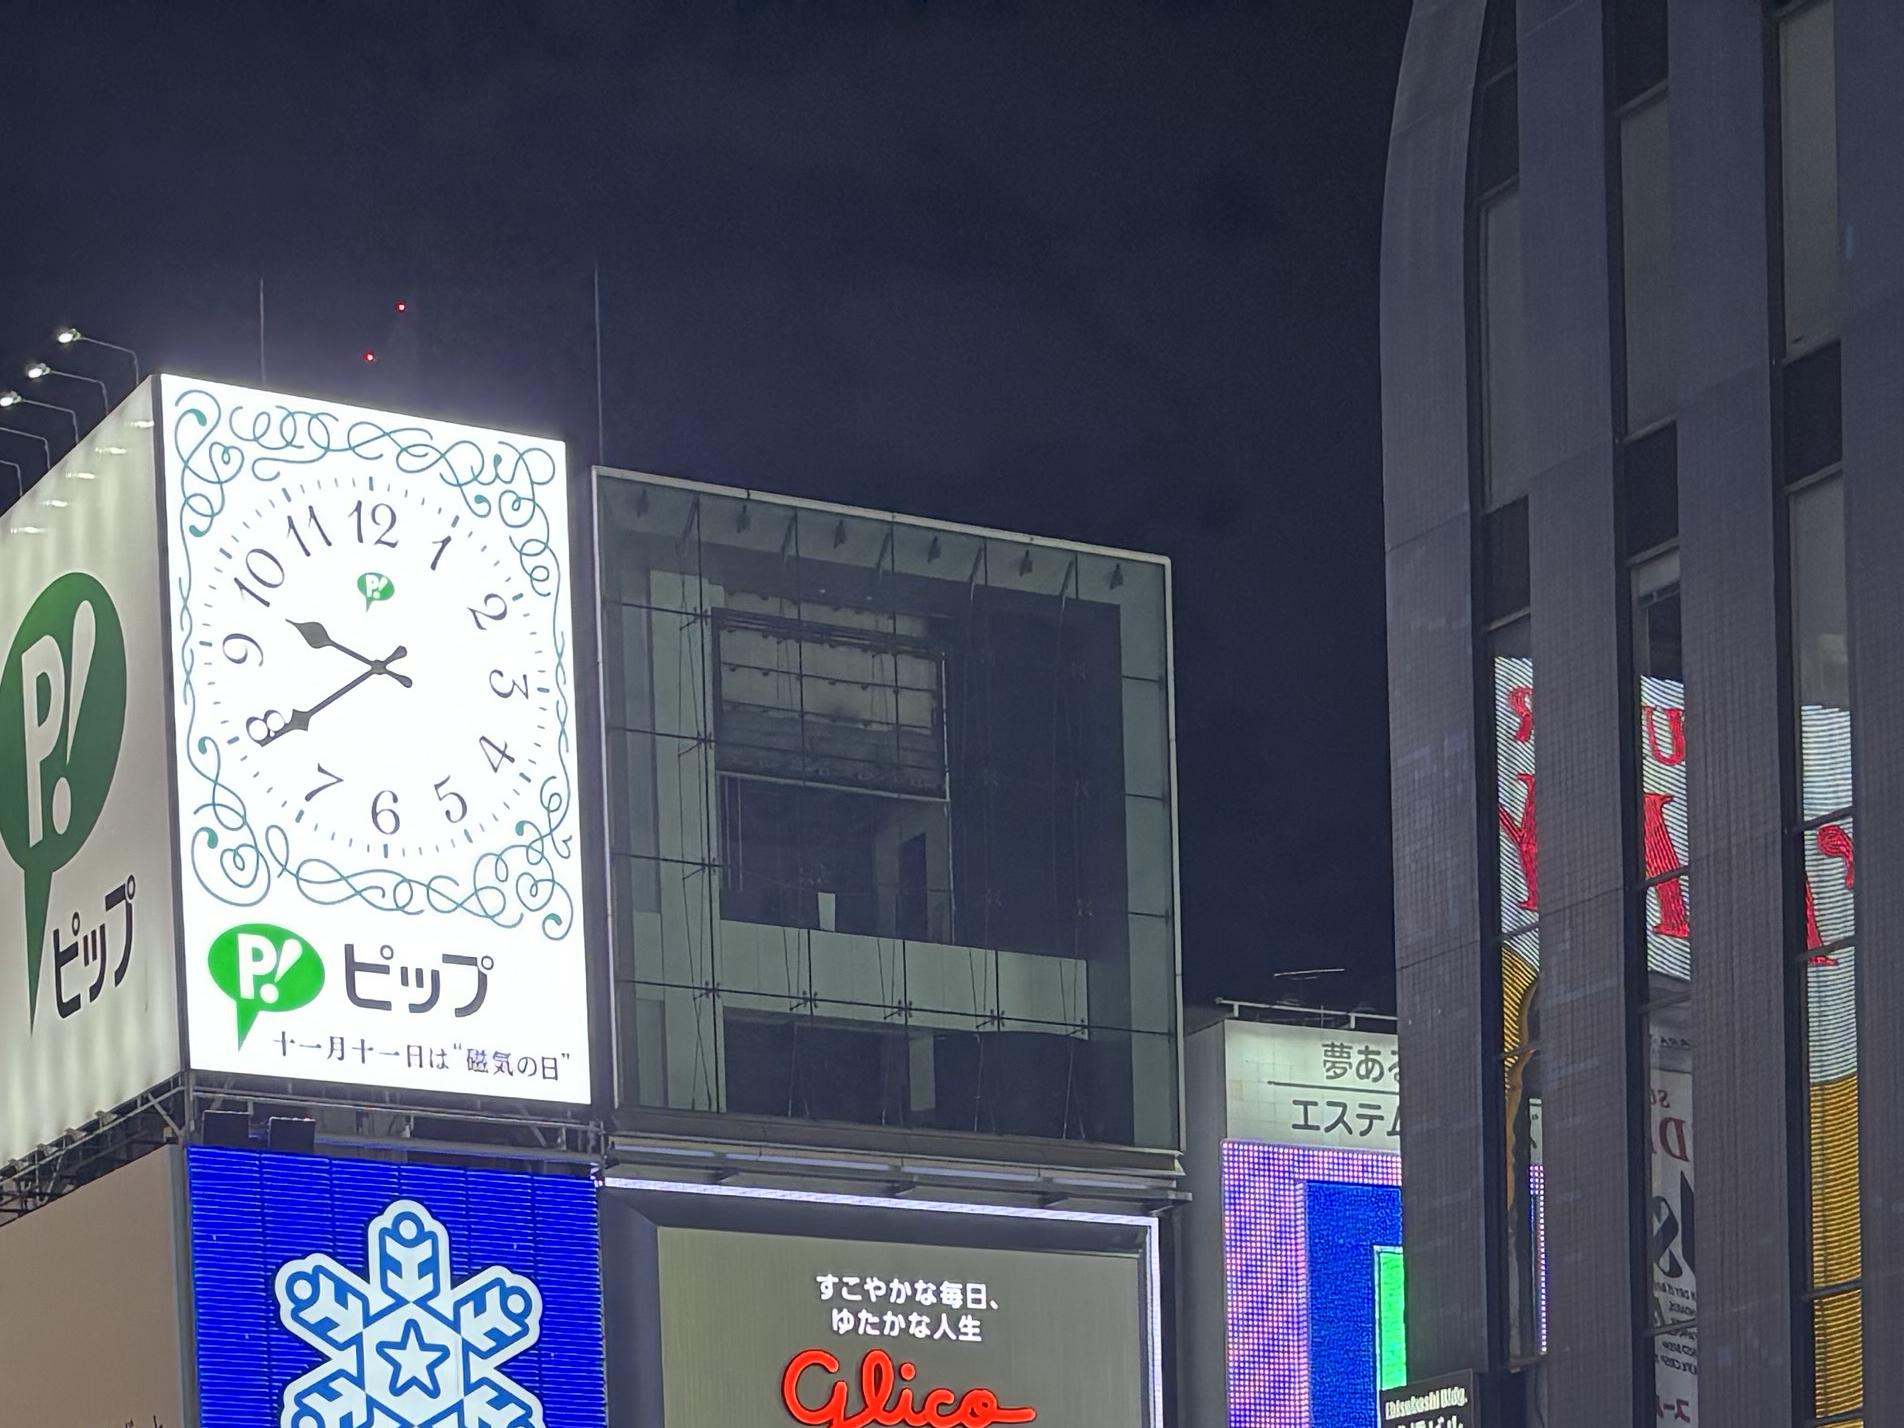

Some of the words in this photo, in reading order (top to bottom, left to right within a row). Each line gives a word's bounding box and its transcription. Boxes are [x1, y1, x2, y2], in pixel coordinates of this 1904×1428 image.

[284, 504, 334, 559] 11
[350, 499, 398, 550] 12
[429, 534, 452, 571] 1
[232, 546, 288, 609] 10
[467, 591, 509, 633] 2
[221, 631, 266, 669] 9
[488, 668, 530, 701] 3
[477, 733, 517, 774] 4
[303, 763, 345, 802] 7
[432, 774, 469, 824] 5
[370, 789, 402, 837] 6
[52, 873, 136, 1020] ピップ
[344, 943, 496, 1018] ピップ
[814, 1272, 1001, 1312] すこやかな毎日、
[830, 1309, 983, 1343] ゆたかな人生
